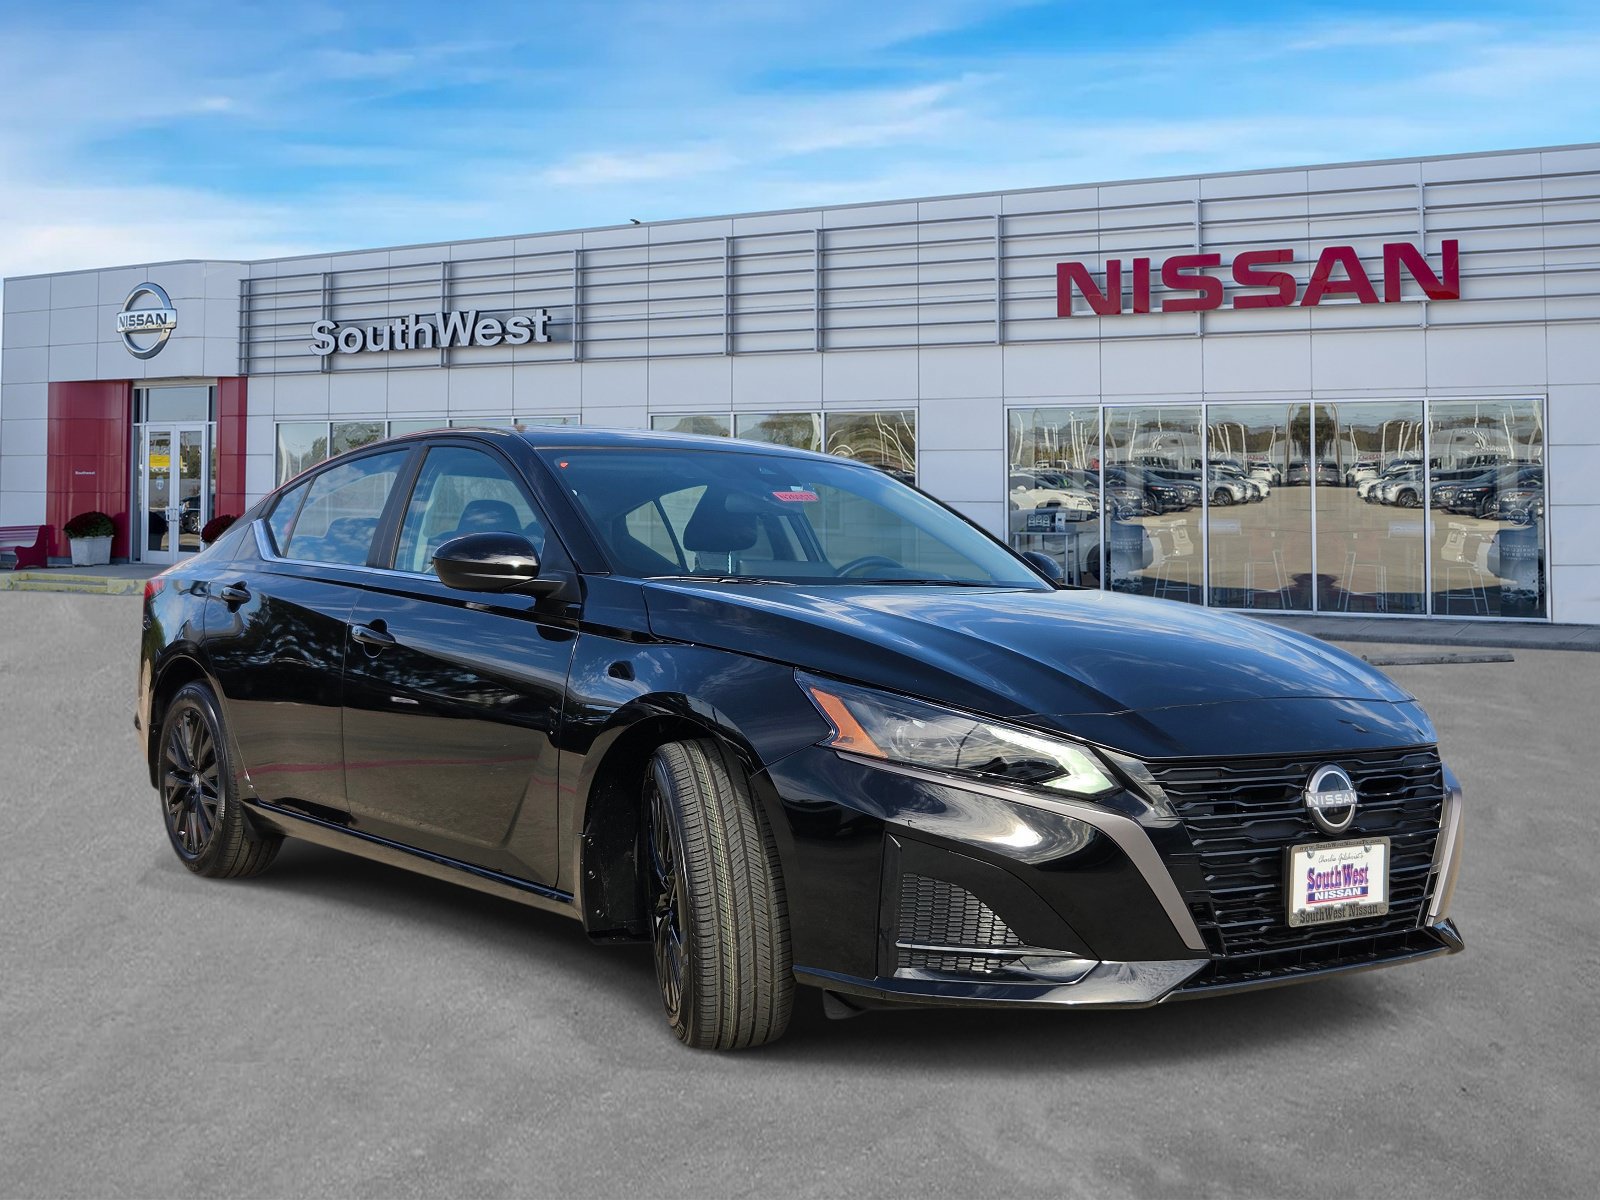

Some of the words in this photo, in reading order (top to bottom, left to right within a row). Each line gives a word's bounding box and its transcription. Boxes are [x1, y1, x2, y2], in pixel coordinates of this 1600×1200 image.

[1056, 239, 1461, 318] NISSAN
[119, 312, 167, 328] NISSAN
[309, 308, 550, 356] SouthWest
[1306, 792, 1357, 806] NISSAN
[1306, 863, 1369, 891] SouthWest
[1314, 887, 1361, 901] NISSAN
[1299, 905, 1346, 924] SouthWest
[1349, 903, 1378, 917] Nissan
